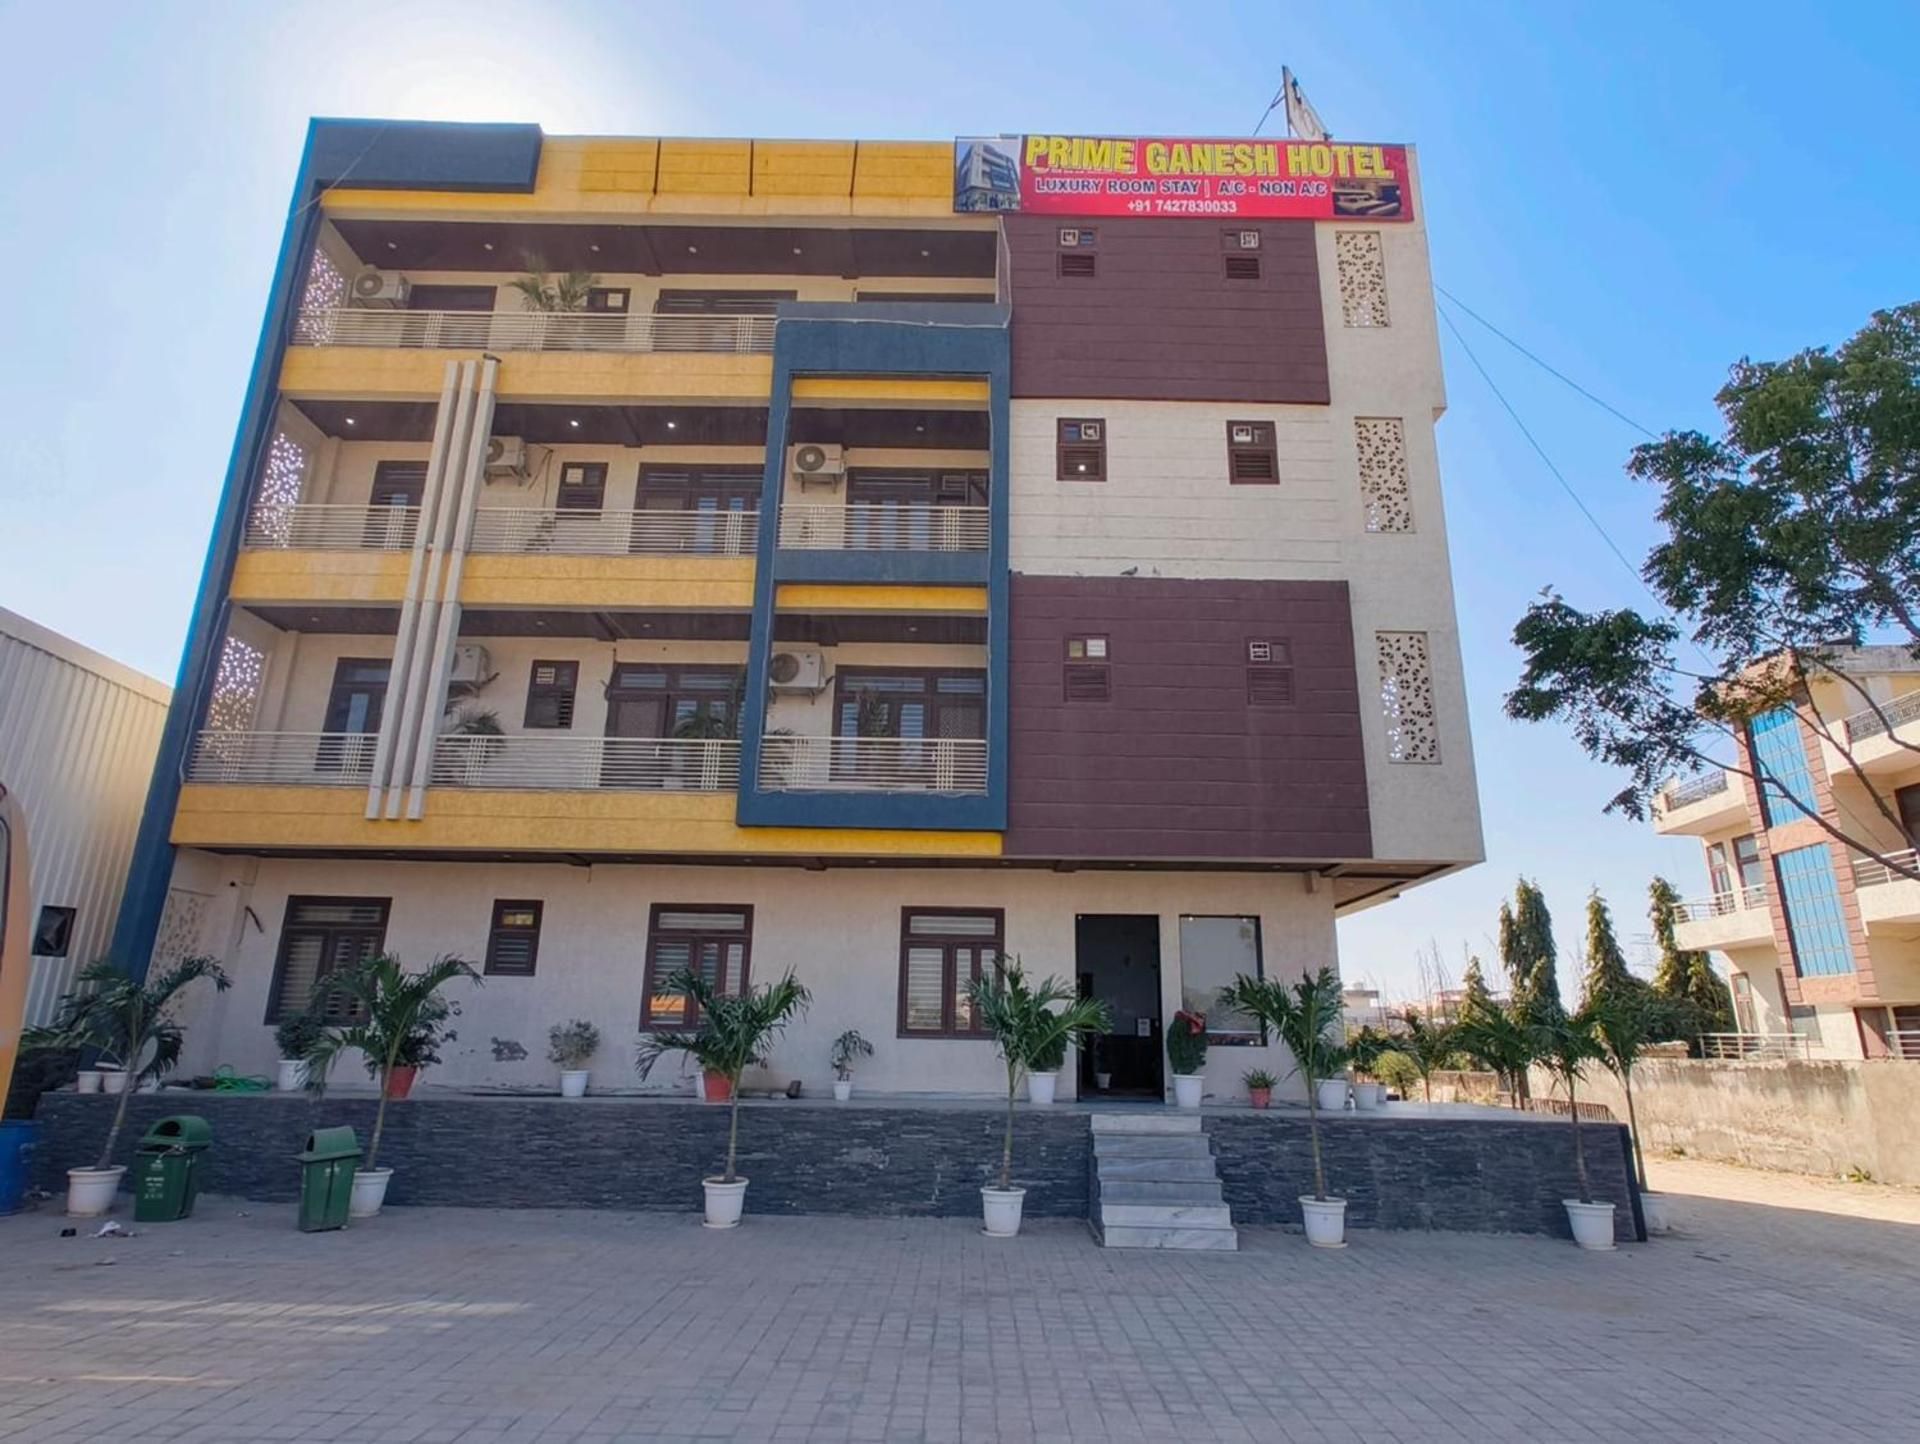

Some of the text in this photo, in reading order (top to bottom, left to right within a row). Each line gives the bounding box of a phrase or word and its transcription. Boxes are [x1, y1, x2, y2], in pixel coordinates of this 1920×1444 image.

[1025, 135, 1394, 178] PRIME GANESH HOTEL
[1035, 177, 1101, 194] LUXURY
[1107, 180, 1156, 194] ROOM
[1159, 180, 1200, 195] STAY
[1258, 180, 1296, 196] NON
[1127, 200, 1237, 212] +91 7427830033
